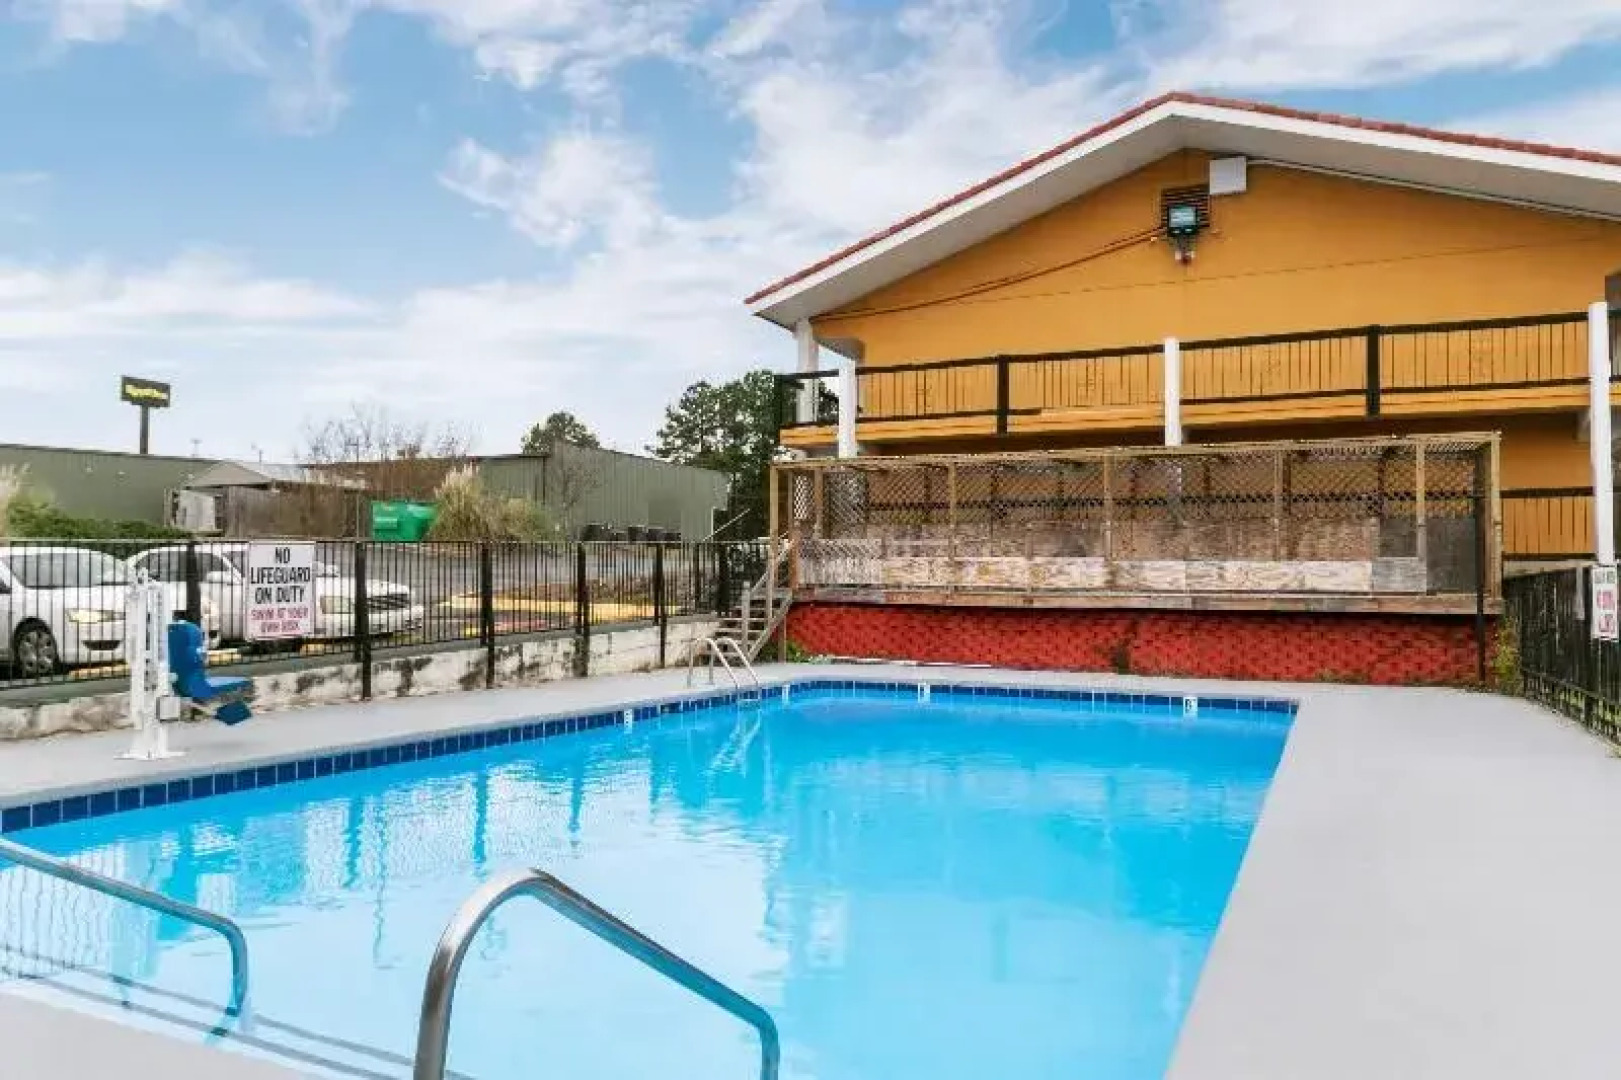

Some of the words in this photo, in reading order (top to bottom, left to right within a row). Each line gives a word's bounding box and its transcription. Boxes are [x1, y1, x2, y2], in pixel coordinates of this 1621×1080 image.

[275, 546, 290, 563] NO
[250, 567, 311, 584] LIFEGUARD
[255, 587, 272, 604] ON
[277, 586, 304, 602] DUTY
